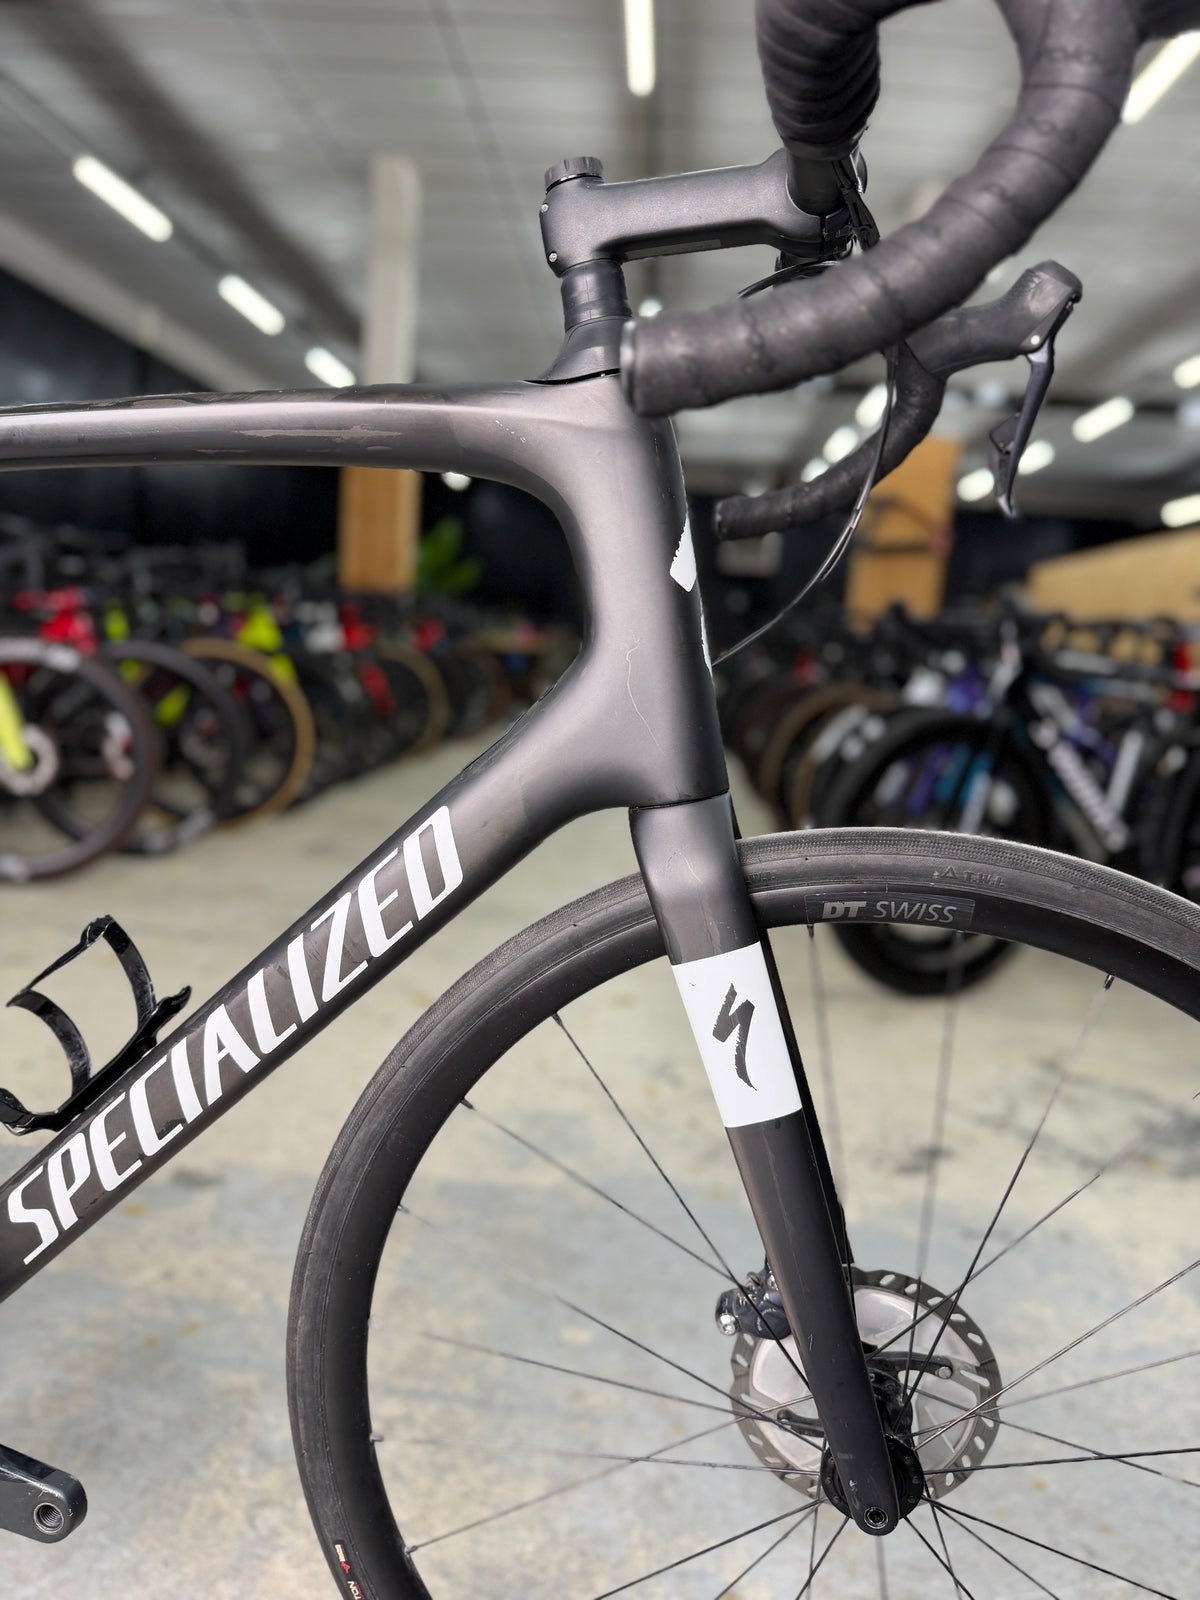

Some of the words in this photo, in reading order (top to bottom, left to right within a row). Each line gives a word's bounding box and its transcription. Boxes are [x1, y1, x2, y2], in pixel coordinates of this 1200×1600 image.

[822, 901, 867, 919] DT
[873, 901, 957, 923] SWISS
[8, 806, 464, 1265] SPECIALIZED
